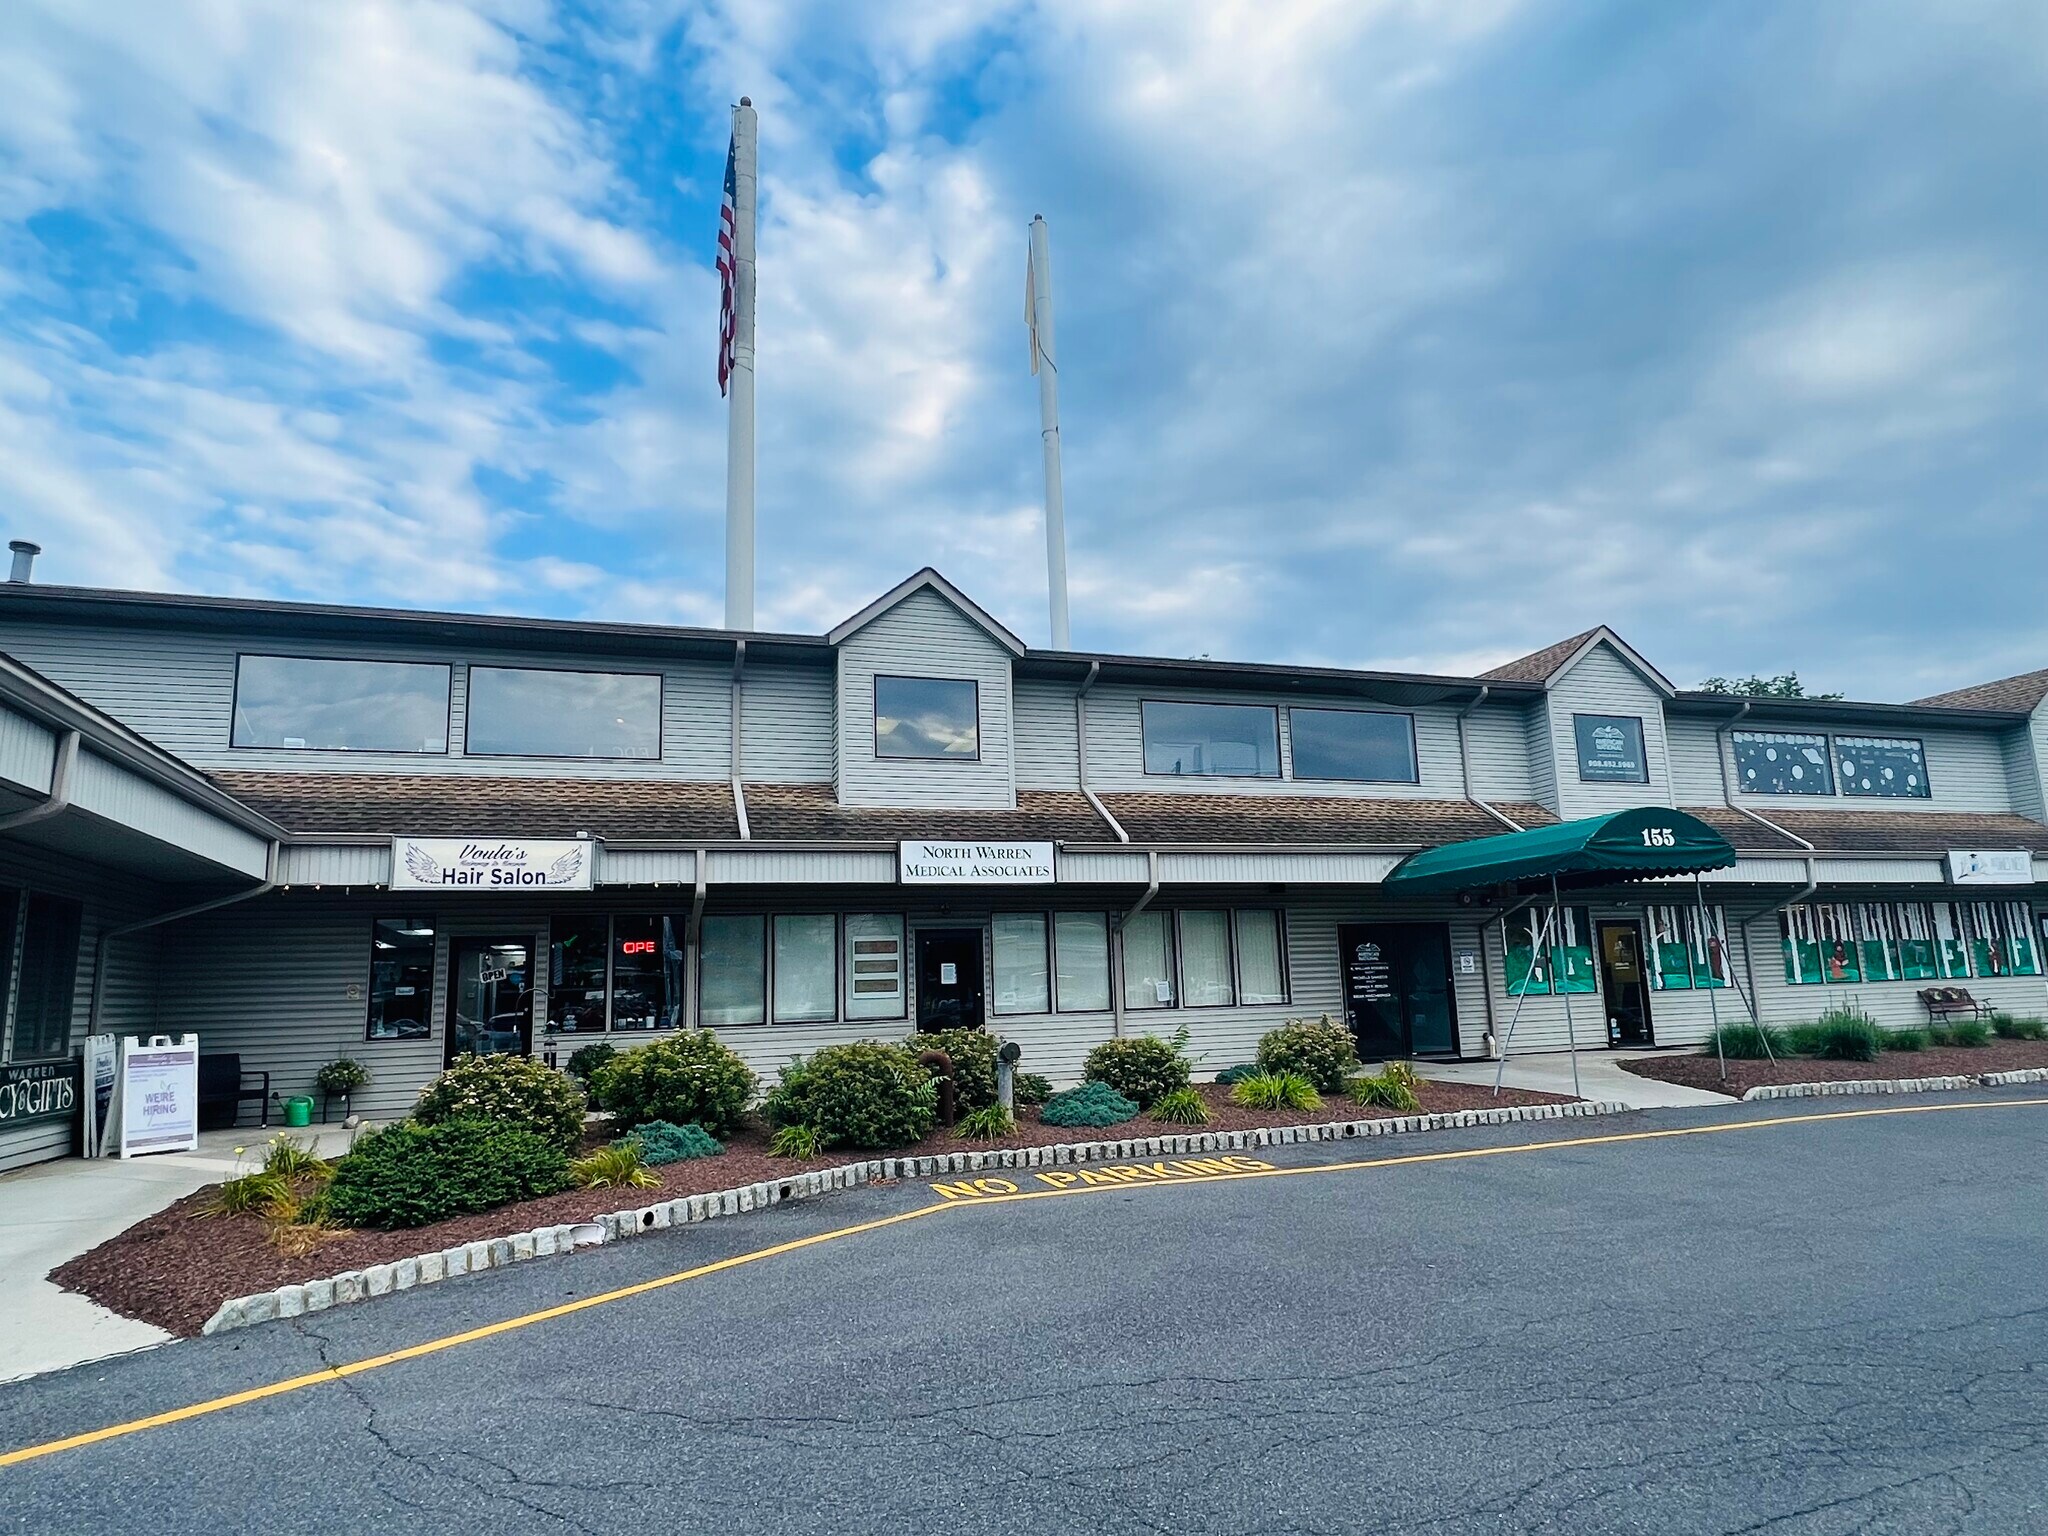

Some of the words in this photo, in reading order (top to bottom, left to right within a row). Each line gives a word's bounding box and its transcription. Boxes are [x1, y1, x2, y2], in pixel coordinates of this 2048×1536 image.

[1641, 828, 1676, 847] 155
[458, 844, 528, 860] Voula's
[922, 846, 971, 859] NORTH
[975, 846, 1032, 859] WARREN
[442, 868, 484, 885] Hair
[490, 868, 546, 885] Salon
[905, 864, 966, 877] MEDICAL
[970, 864, 1050, 877] ASSOCIATES
[482, 969, 505, 982] OPEN
[143, 1104, 177, 1116] HIRING
[929, 1177, 1020, 1200] NO
[1034, 1155, 1276, 1188] PARKING
